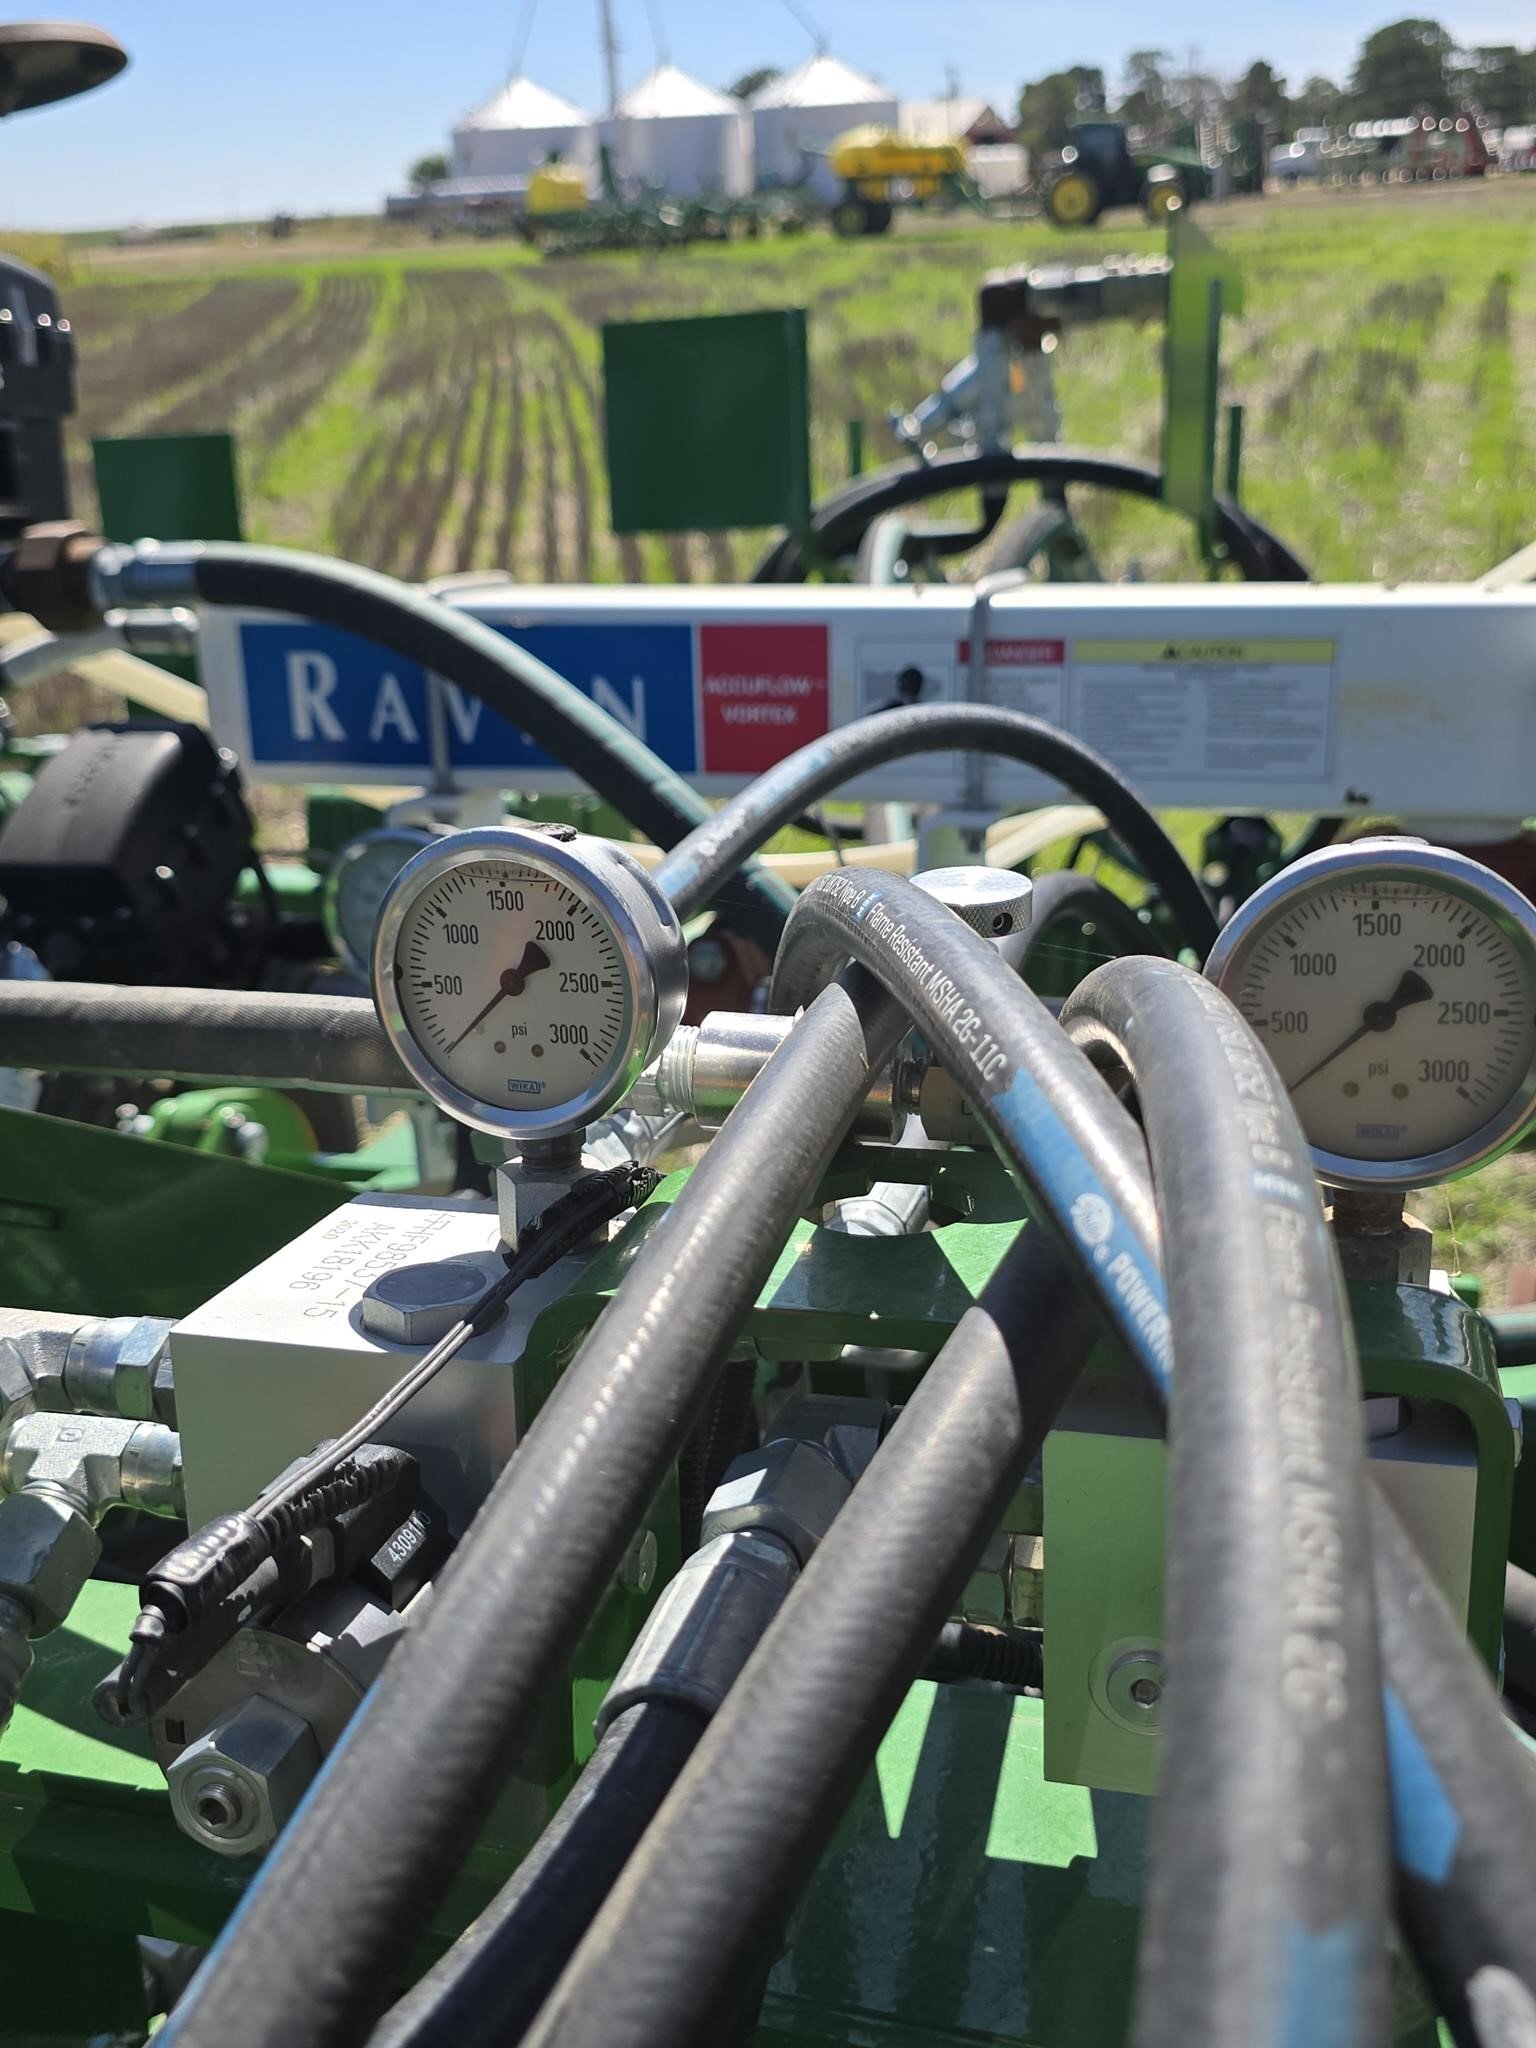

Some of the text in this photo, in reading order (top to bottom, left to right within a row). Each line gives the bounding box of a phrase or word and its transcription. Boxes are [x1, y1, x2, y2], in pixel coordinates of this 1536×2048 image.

[285, 649, 646, 743] RAVN
[486, 890, 524, 911] 1500
[442, 924, 479, 944] 1000
[535, 920, 575, 942] 2000
[1352, 913, 1401, 936] 1500
[1289, 953, 1336, 976] 1000
[1413, 944, 1465, 967] 2000
[434, 975, 463, 995] 500
[559, 972, 599, 993] 2500
[865, 901, 891, 939] Flame
[887, 925, 935, 986] Resistant
[924, 969, 966, 1022] MSHA
[952, 1007, 1008, 1081] 2G-11C
[1271, 1011, 1308, 1033] 500
[1437, 1002, 1490, 1025] 2500
[511, 1022, 528, 1037] psi
[549, 1024, 588, 1045] 3000
[1368, 1060, 1389, 1078] psi
[1418, 1060, 1469, 1082] 3000
[510, 1080, 538, 1092] WIKA
[289, 1221, 396, 1290] AKK18196
